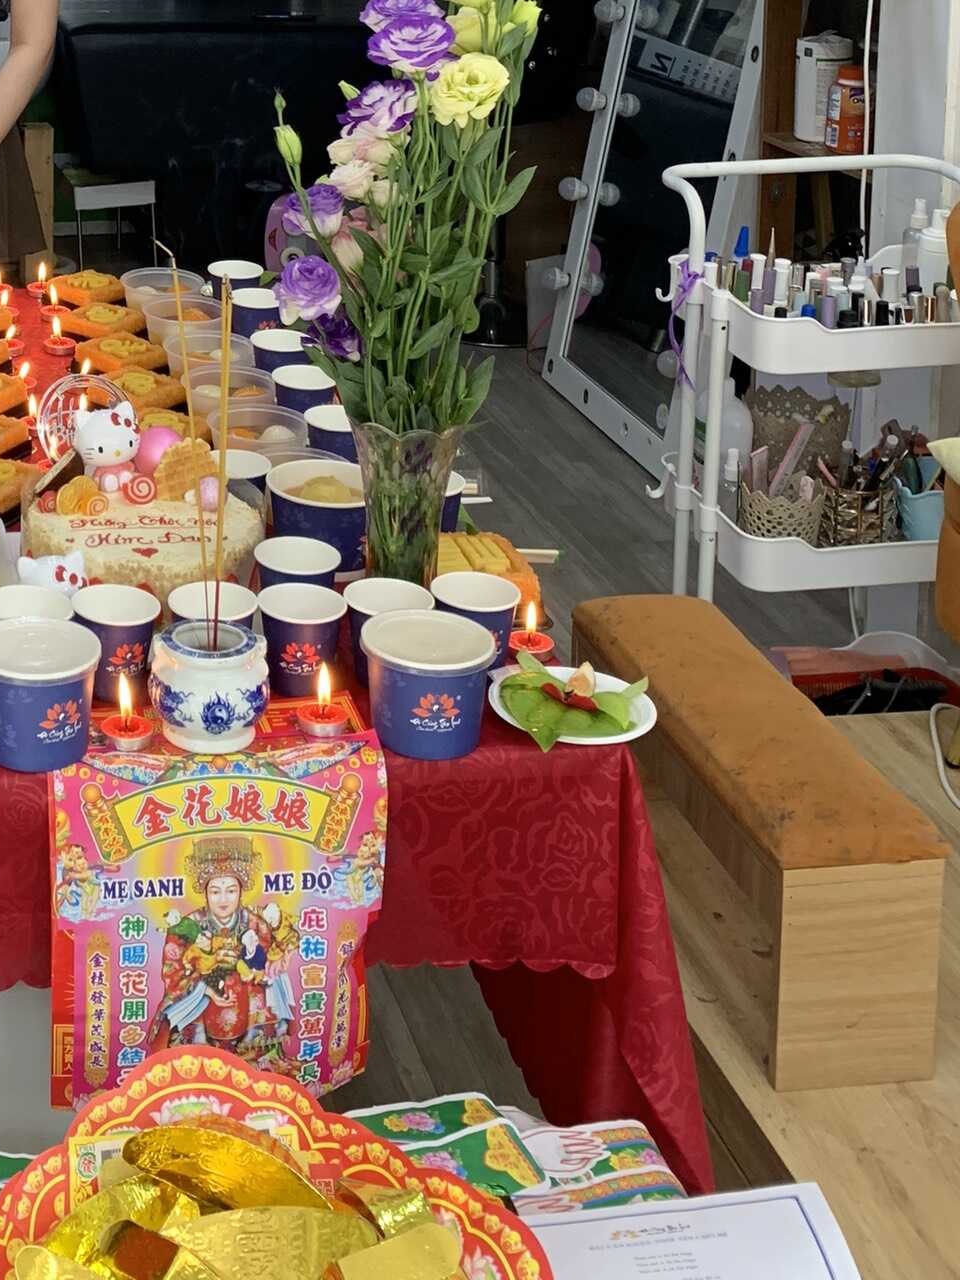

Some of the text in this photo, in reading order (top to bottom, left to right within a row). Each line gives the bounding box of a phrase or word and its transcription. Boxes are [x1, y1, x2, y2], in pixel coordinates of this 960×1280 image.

[135, 783, 312, 839] 金花娘娘
[103, 877, 185, 904] MẸ SANH
[264, 866, 332, 896] MẸ ĐỘ
